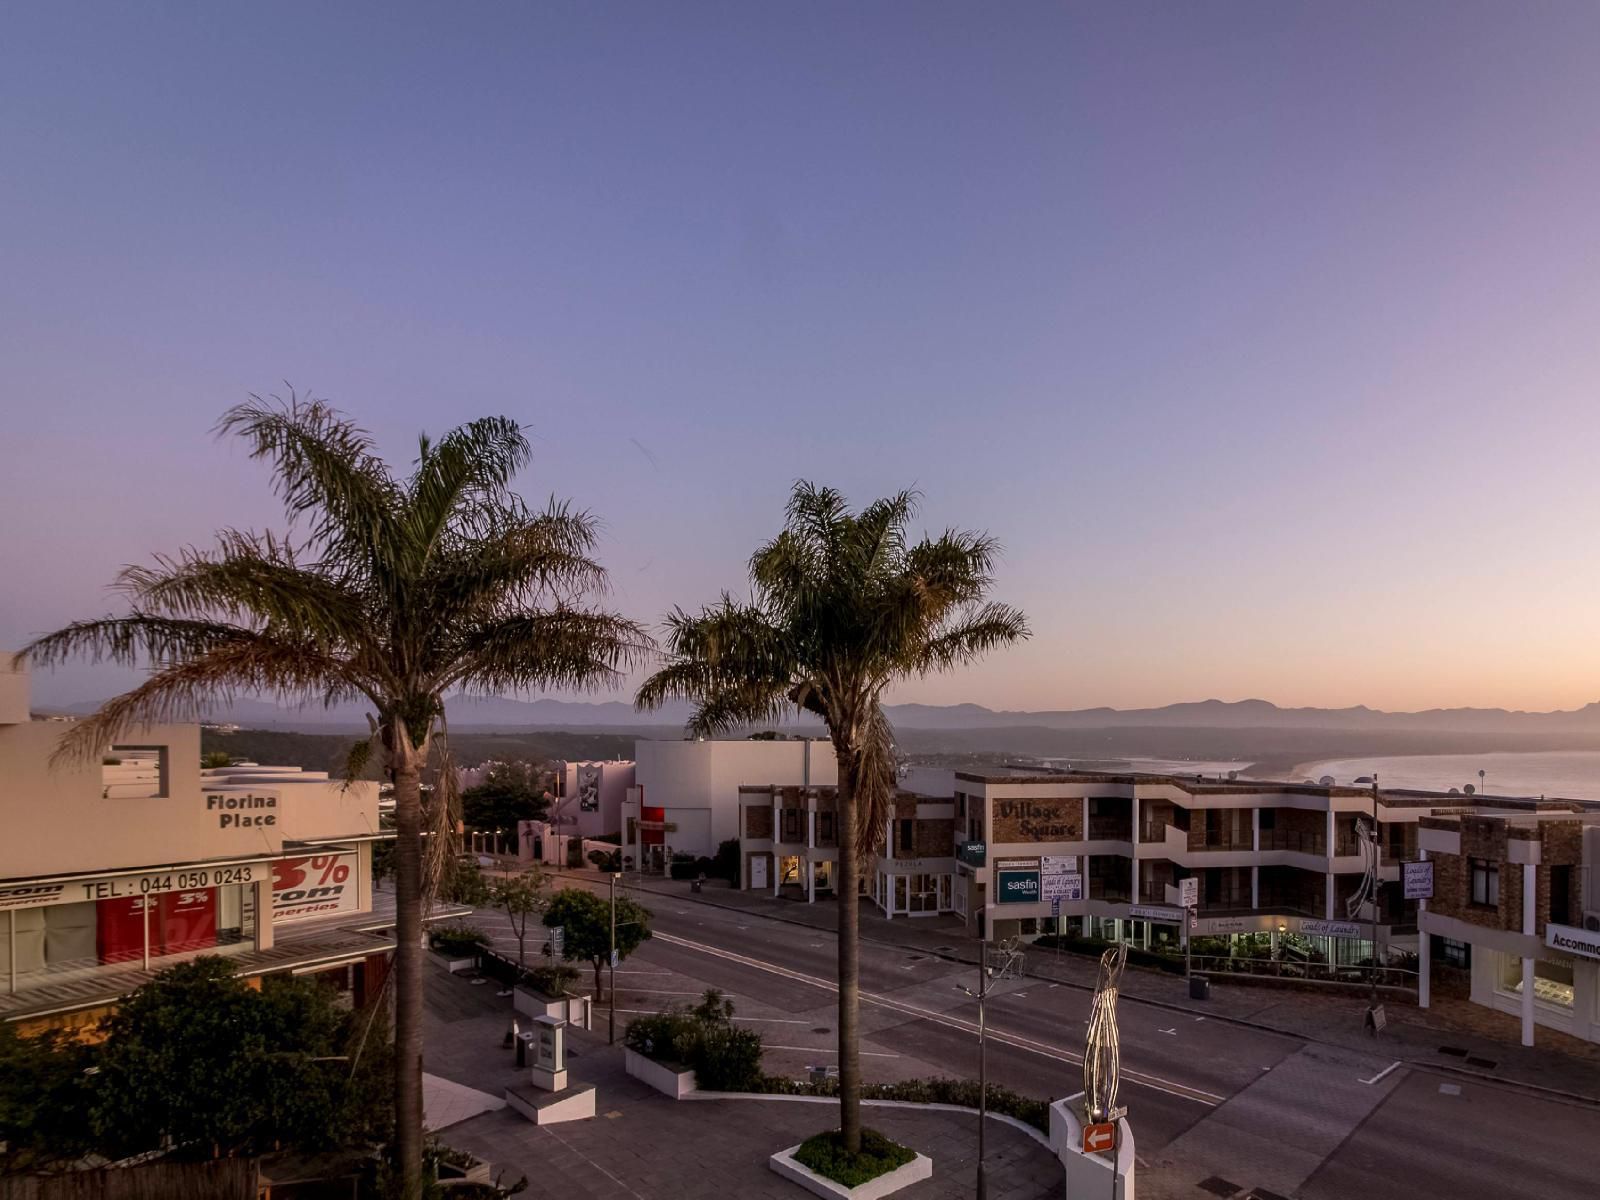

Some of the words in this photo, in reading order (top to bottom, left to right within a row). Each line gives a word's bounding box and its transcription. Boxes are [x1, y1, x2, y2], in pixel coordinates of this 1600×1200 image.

[207, 794, 277, 810] Florina
[1001, 800, 1060, 821] Village
[220, 813, 276, 829] Place
[1020, 820, 1076, 842] Square
[967, 844, 985, 852] sasfin
[82, 882, 122, 900] TEL
[141, 876, 172, 894] 044
[178, 872, 208, 889] 050
[214, 867, 252, 886] 0243
[1007, 878, 1038, 890] sasfin
